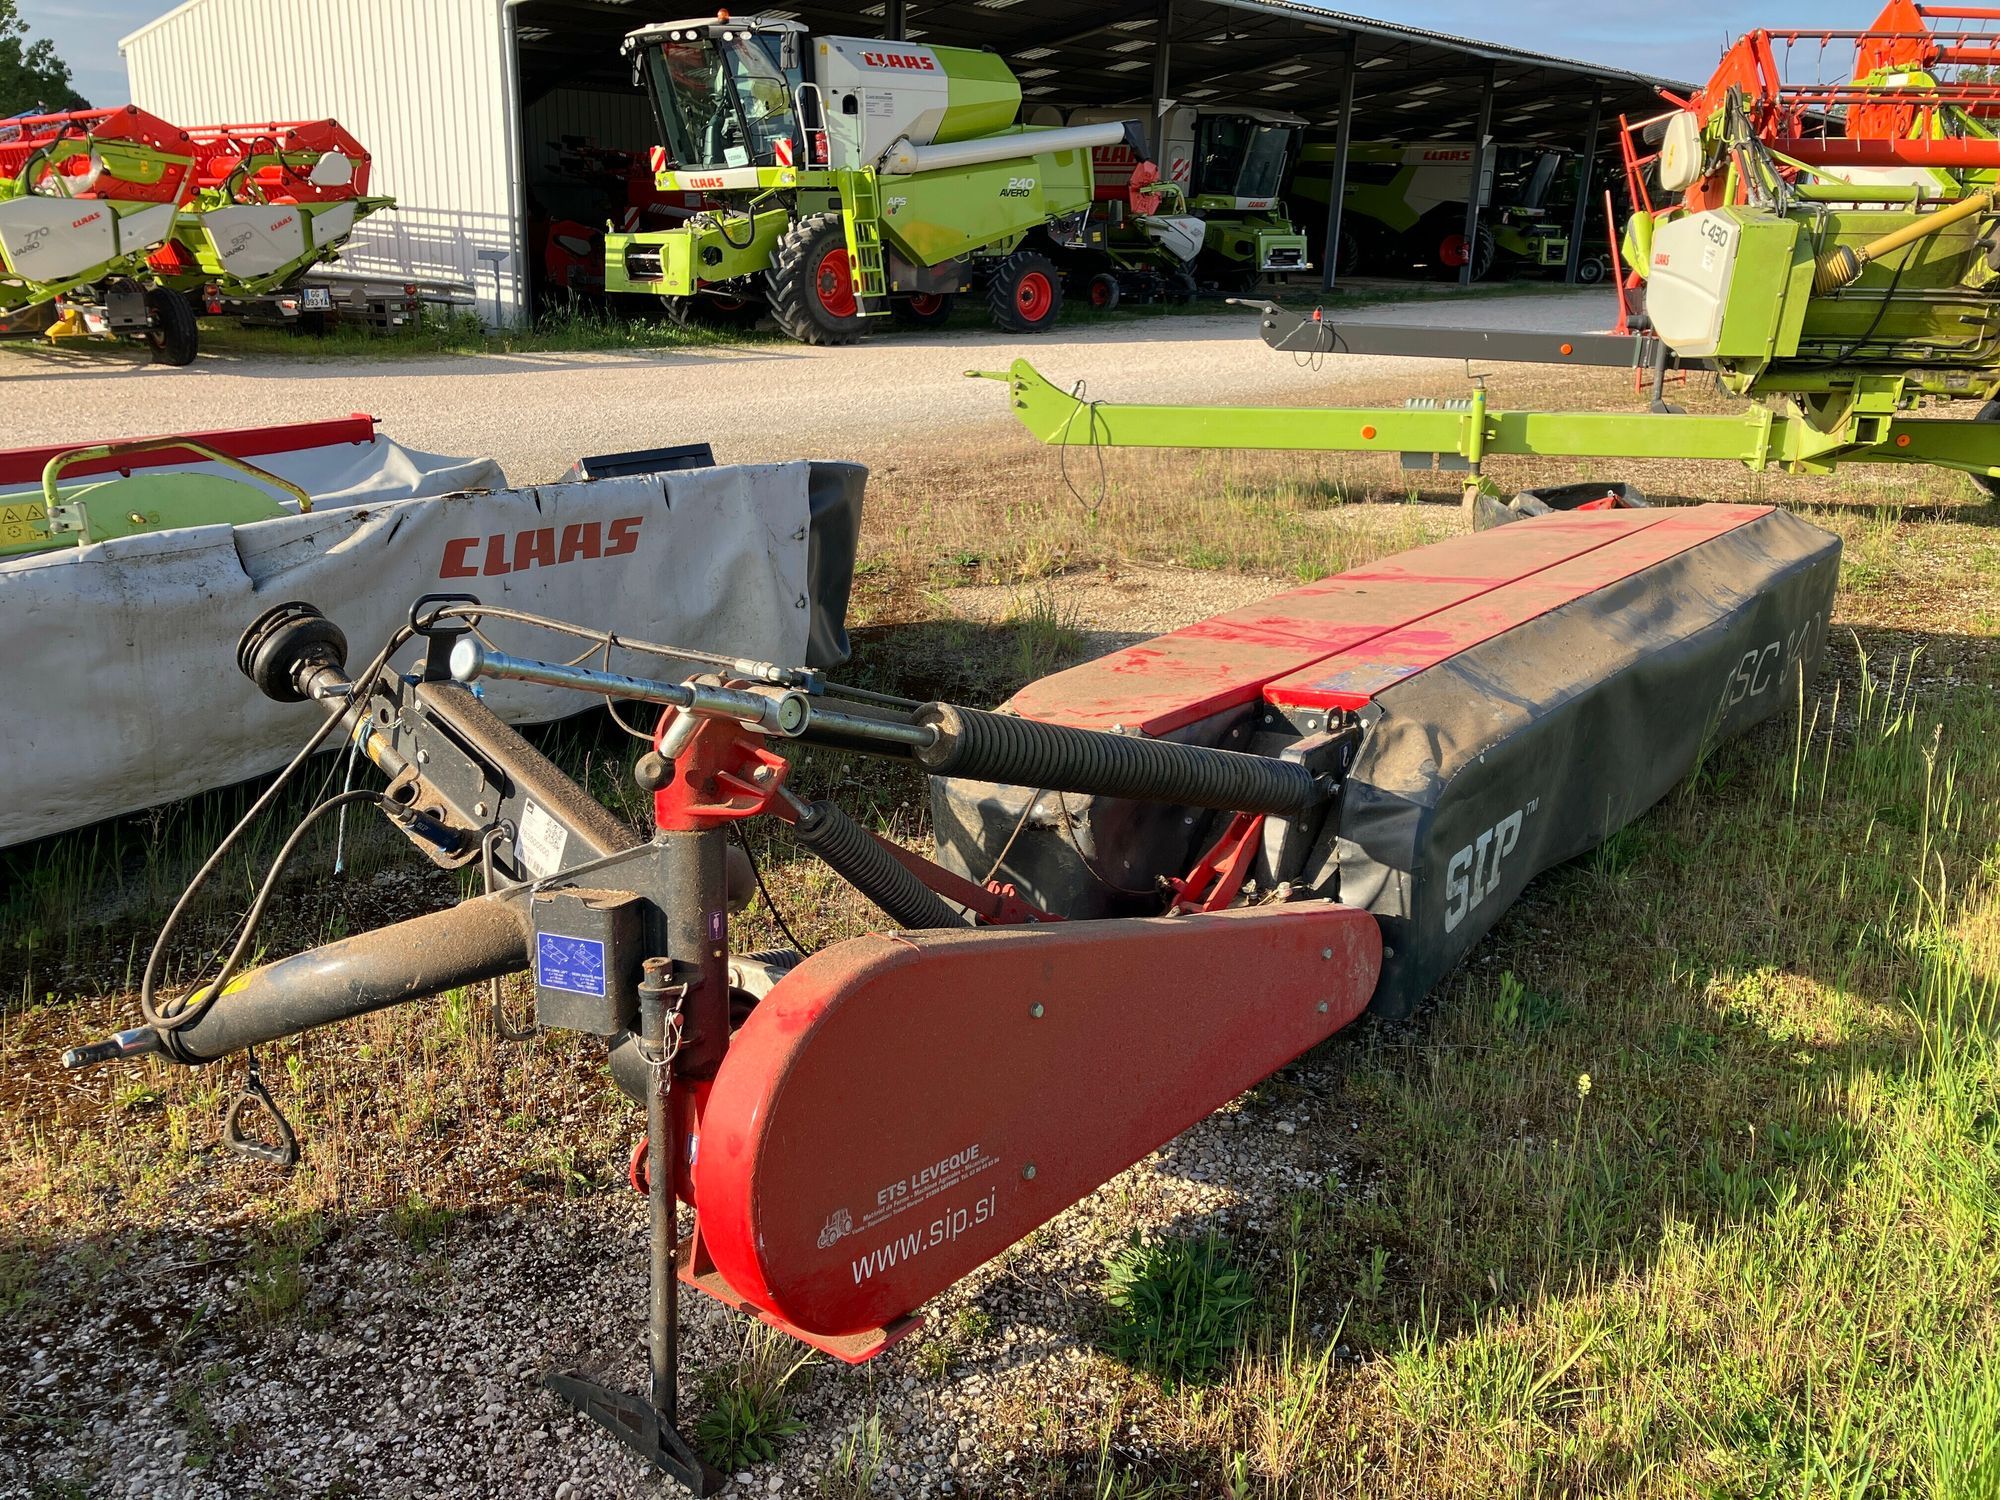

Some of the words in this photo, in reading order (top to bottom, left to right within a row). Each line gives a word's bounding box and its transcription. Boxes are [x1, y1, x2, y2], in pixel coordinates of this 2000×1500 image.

[864, 52, 934, 70] CLAAS
[1423, 151, 1471, 161] CLAAS
[690, 177, 724, 188] CLAAS
[1008, 177, 1036, 190] 240
[887, 197, 907, 206] APS
[1000, 189, 1030, 198] AVERO
[72, 212, 101, 228] CLAAS
[270, 215, 293, 232] CLAAS
[24, 227, 50, 243] 770
[1701, 218, 1709, 237] C
[1708, 223, 1728, 247] 430
[12, 241, 40, 257] VARIO
[223, 244, 246, 258] VARIO
[439, 516, 644, 579] CLAAS
[1445, 809, 1523, 934] SIP
[1525, 797, 1539, 816] TM
[877, 1180, 907, 1206] ETS
[911, 1144, 979, 1190] LEVEQUE
[852, 1185, 996, 1285] www.sip.si
